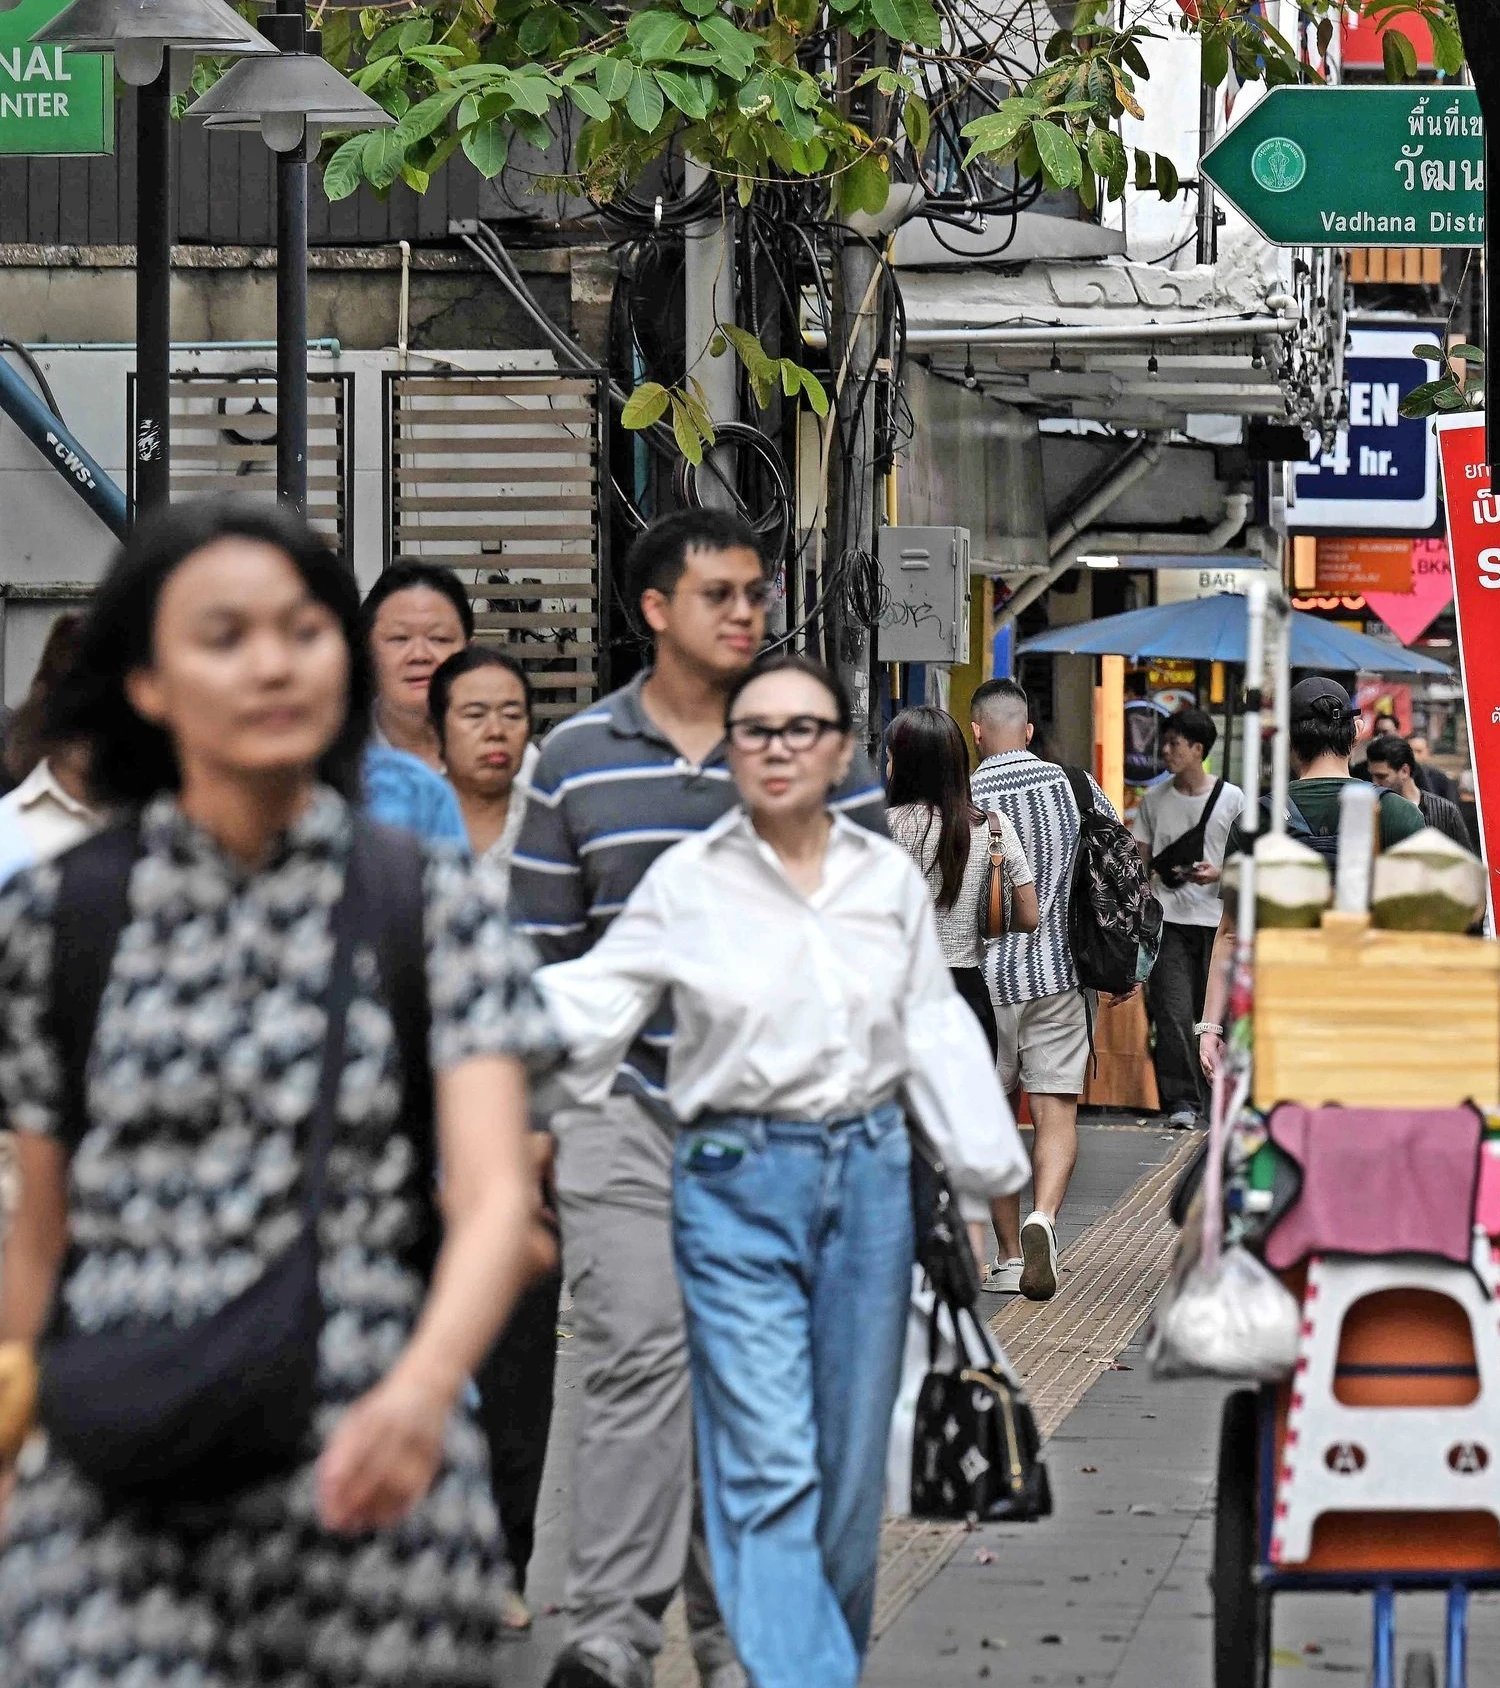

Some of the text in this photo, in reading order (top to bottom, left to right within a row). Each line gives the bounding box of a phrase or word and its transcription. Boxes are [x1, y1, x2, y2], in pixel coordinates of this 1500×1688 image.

[1, 92, 70, 118] NTER
[1320, 211, 1416, 232] Vadhana
[1345, 382, 1400, 427] EN
[1359, 445, 1398, 477] hr.
